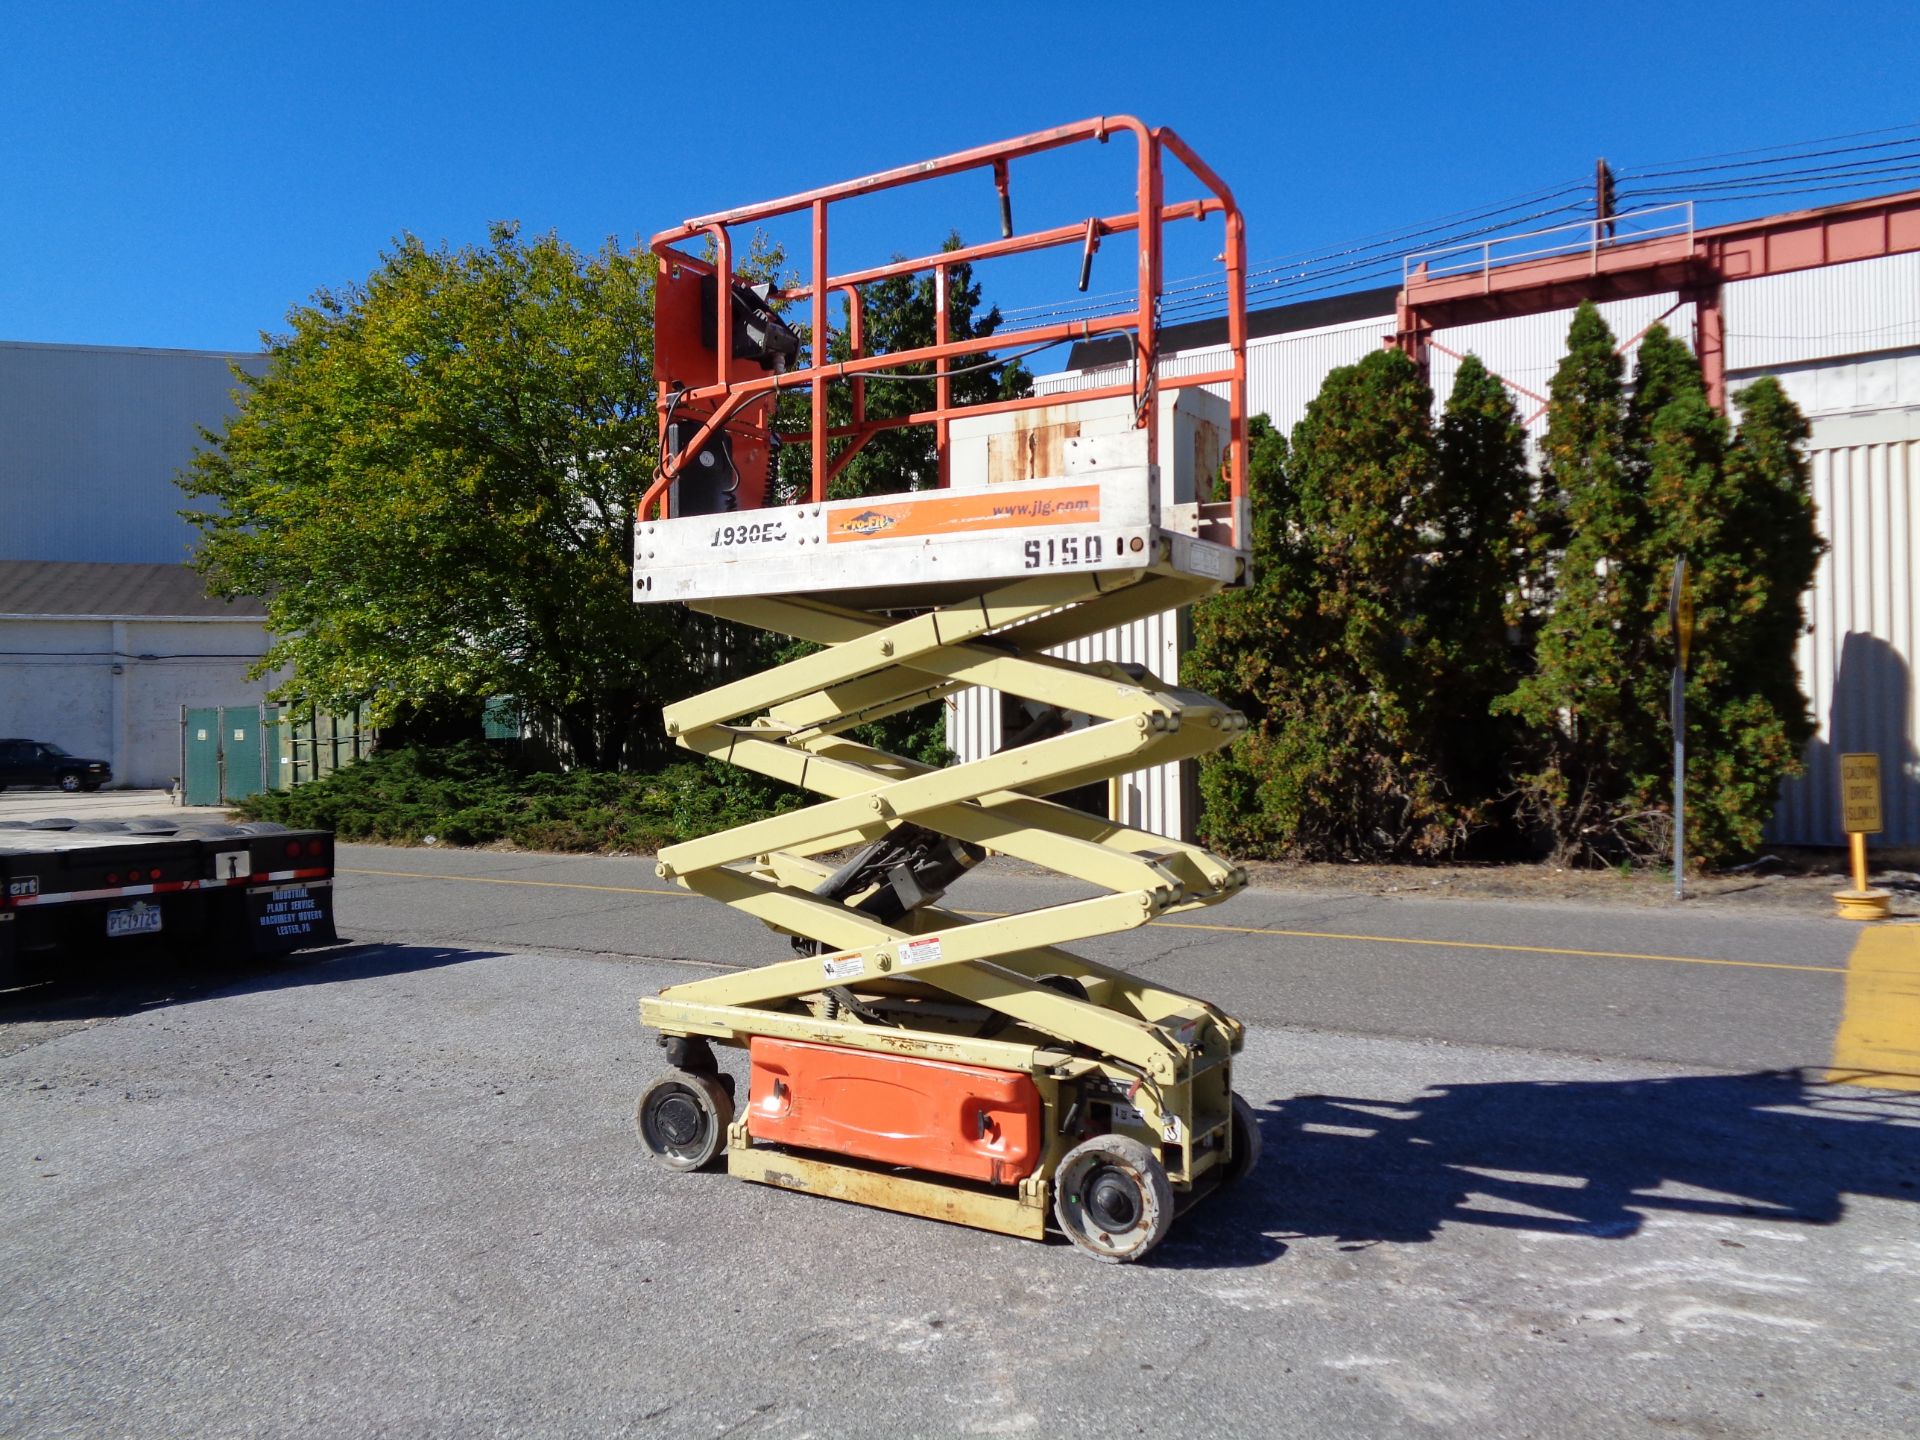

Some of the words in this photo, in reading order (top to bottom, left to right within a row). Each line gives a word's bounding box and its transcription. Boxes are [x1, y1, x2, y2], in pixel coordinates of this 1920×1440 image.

[992, 500, 1089, 518] www.jlg.com
[1024, 535, 1103, 569] S150
[1849, 785, 1873, 800] DRIVE
[1847, 806, 1877, 821] SLOWLY
[266, 902, 288, 913] PLANT
